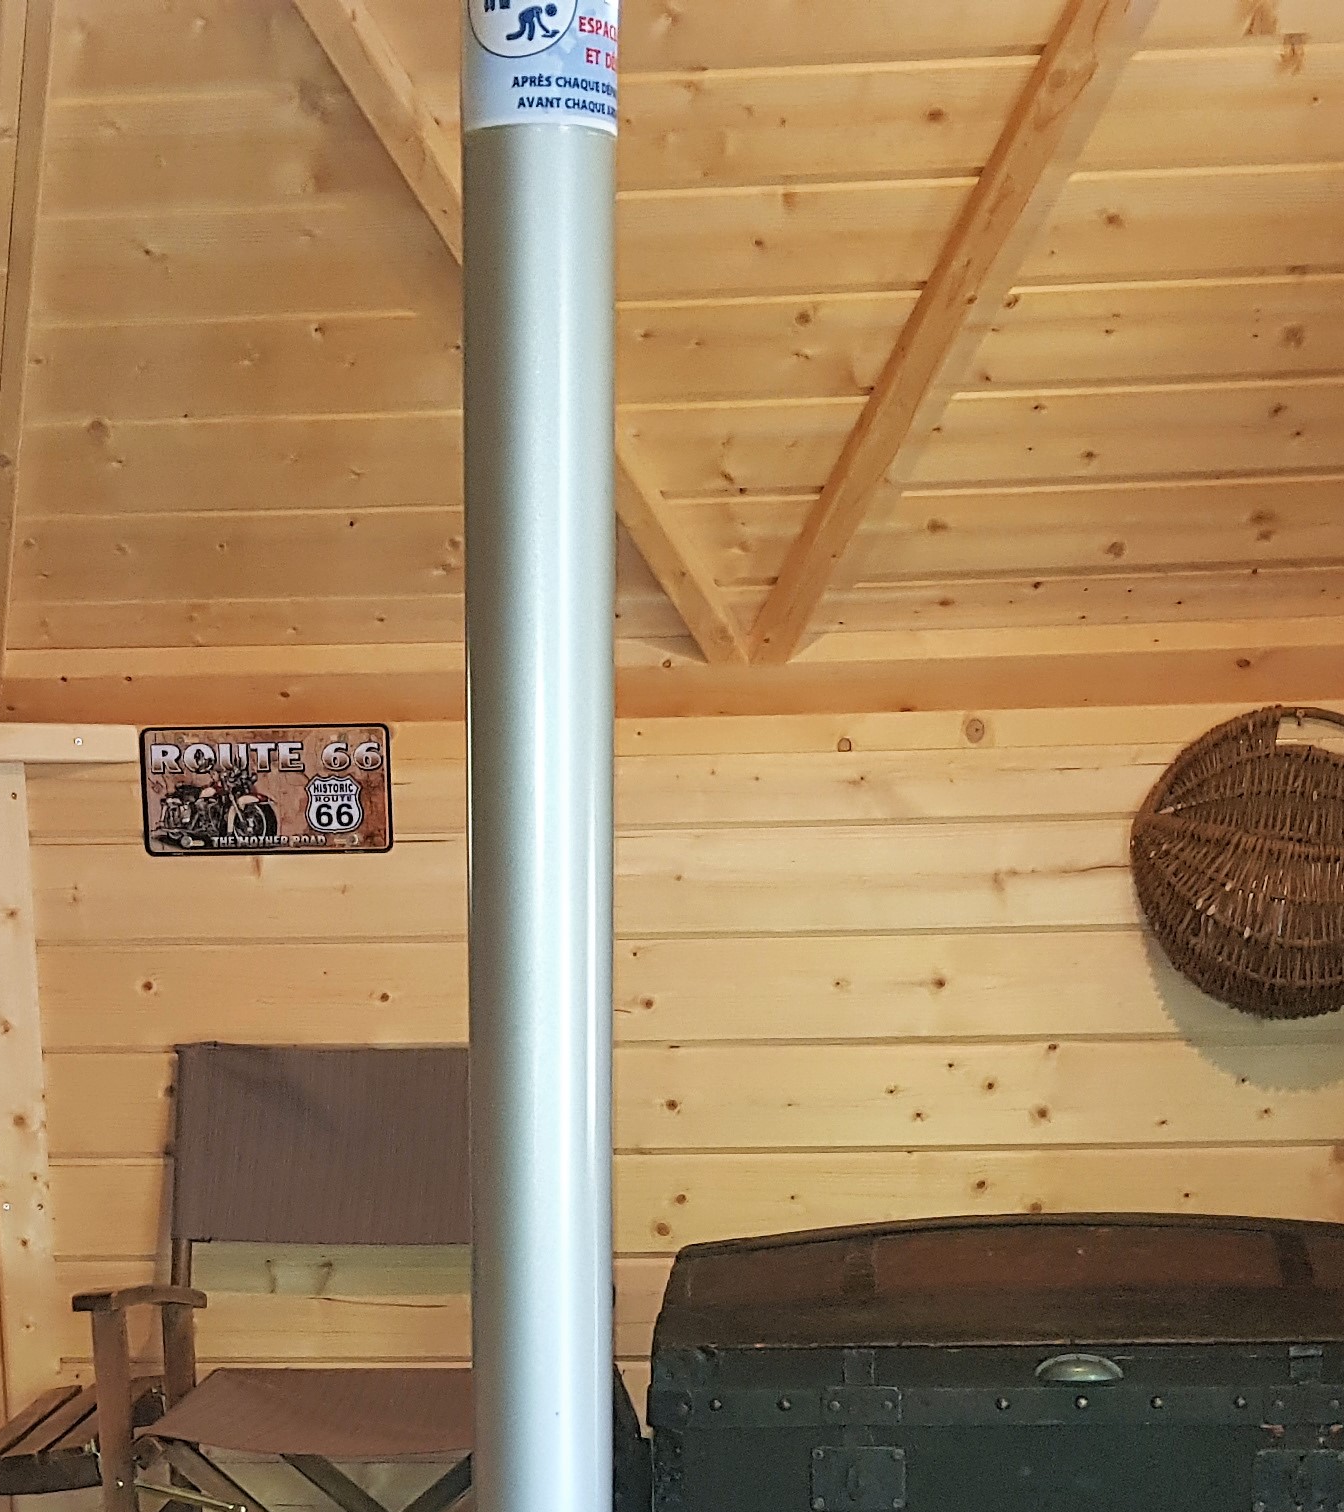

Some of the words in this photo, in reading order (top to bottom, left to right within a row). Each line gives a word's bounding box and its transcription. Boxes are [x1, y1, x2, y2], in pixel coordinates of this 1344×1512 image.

[586, 47, 601, 65] ET
[512, 73, 552, 88] APRÈS
[555, 76, 600, 93] CHAQUE
[517, 97, 562, 109] AVANT
[564, 98, 606, 114] CHAQUE
[150, 742, 305, 774] ROUTE
[321, 741, 383, 771] 66
[313, 783, 354, 793] HISTORIC
[316, 803, 354, 827] 66
[211, 836, 235, 848] THE
[237, 836, 289, 848] MOTHER
[290, 835, 327, 847] ROAD
